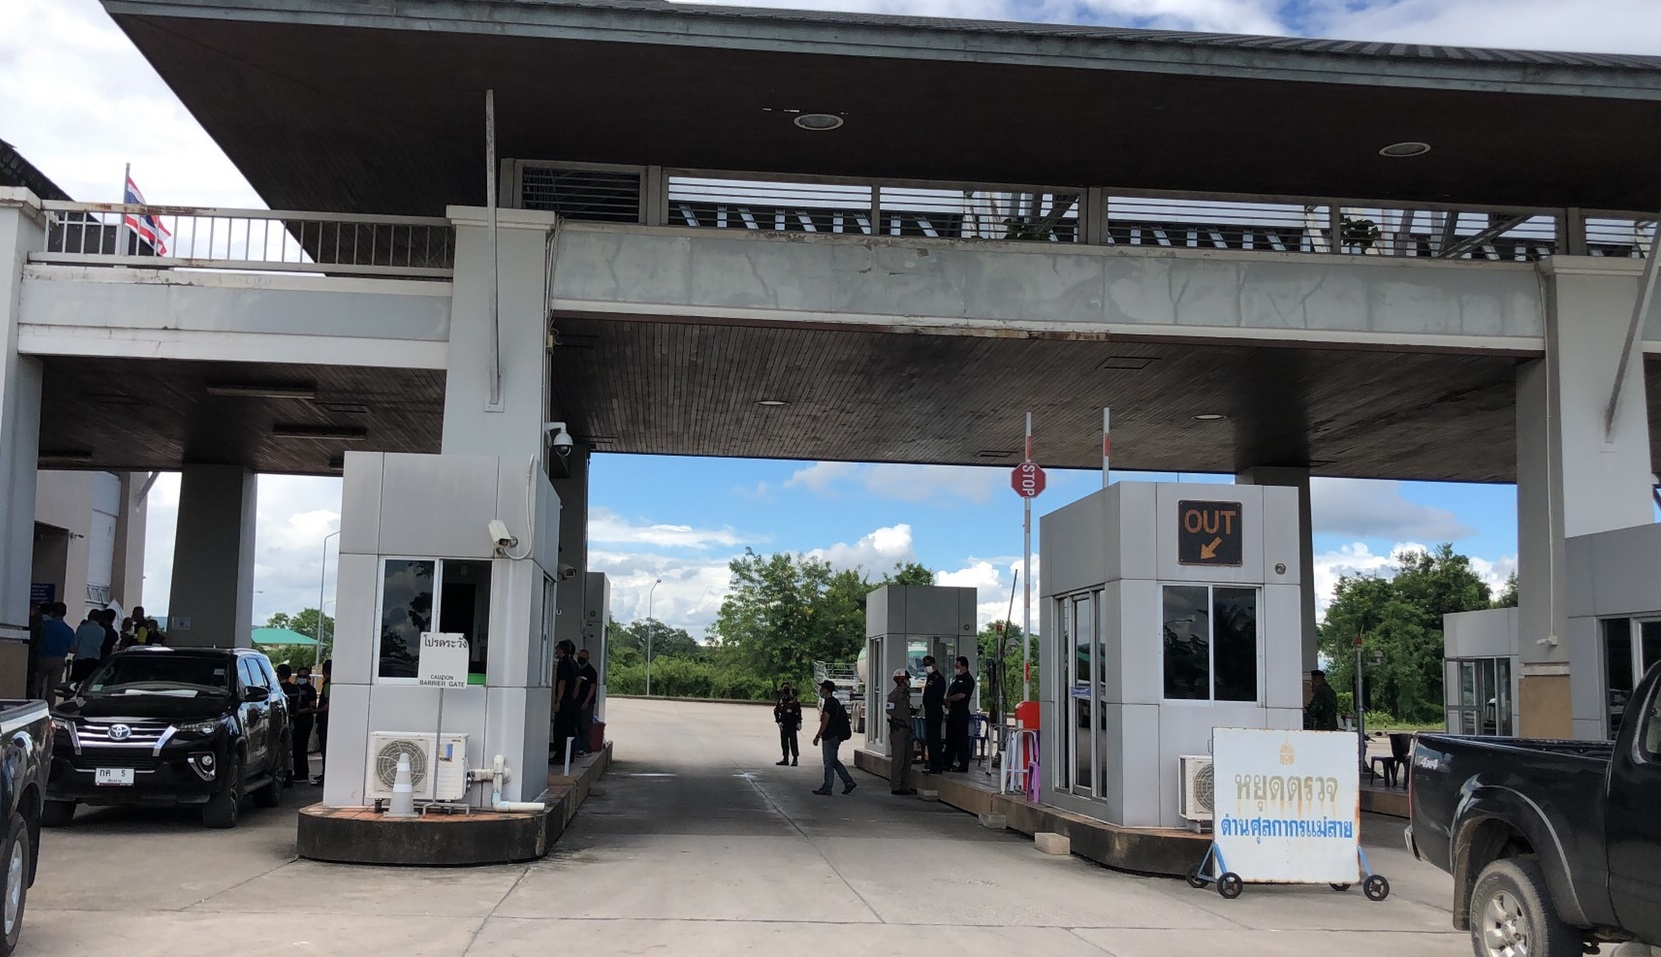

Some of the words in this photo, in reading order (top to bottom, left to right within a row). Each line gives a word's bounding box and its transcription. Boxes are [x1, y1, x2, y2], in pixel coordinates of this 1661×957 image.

[1022, 465, 1035, 496] STOP
[1184, 509, 1236, 535] OUT
[1234, 774, 1338, 812] หยุดตรวจ
[1220, 813, 1353, 844] ด่านศุลกากรแม่สาย
